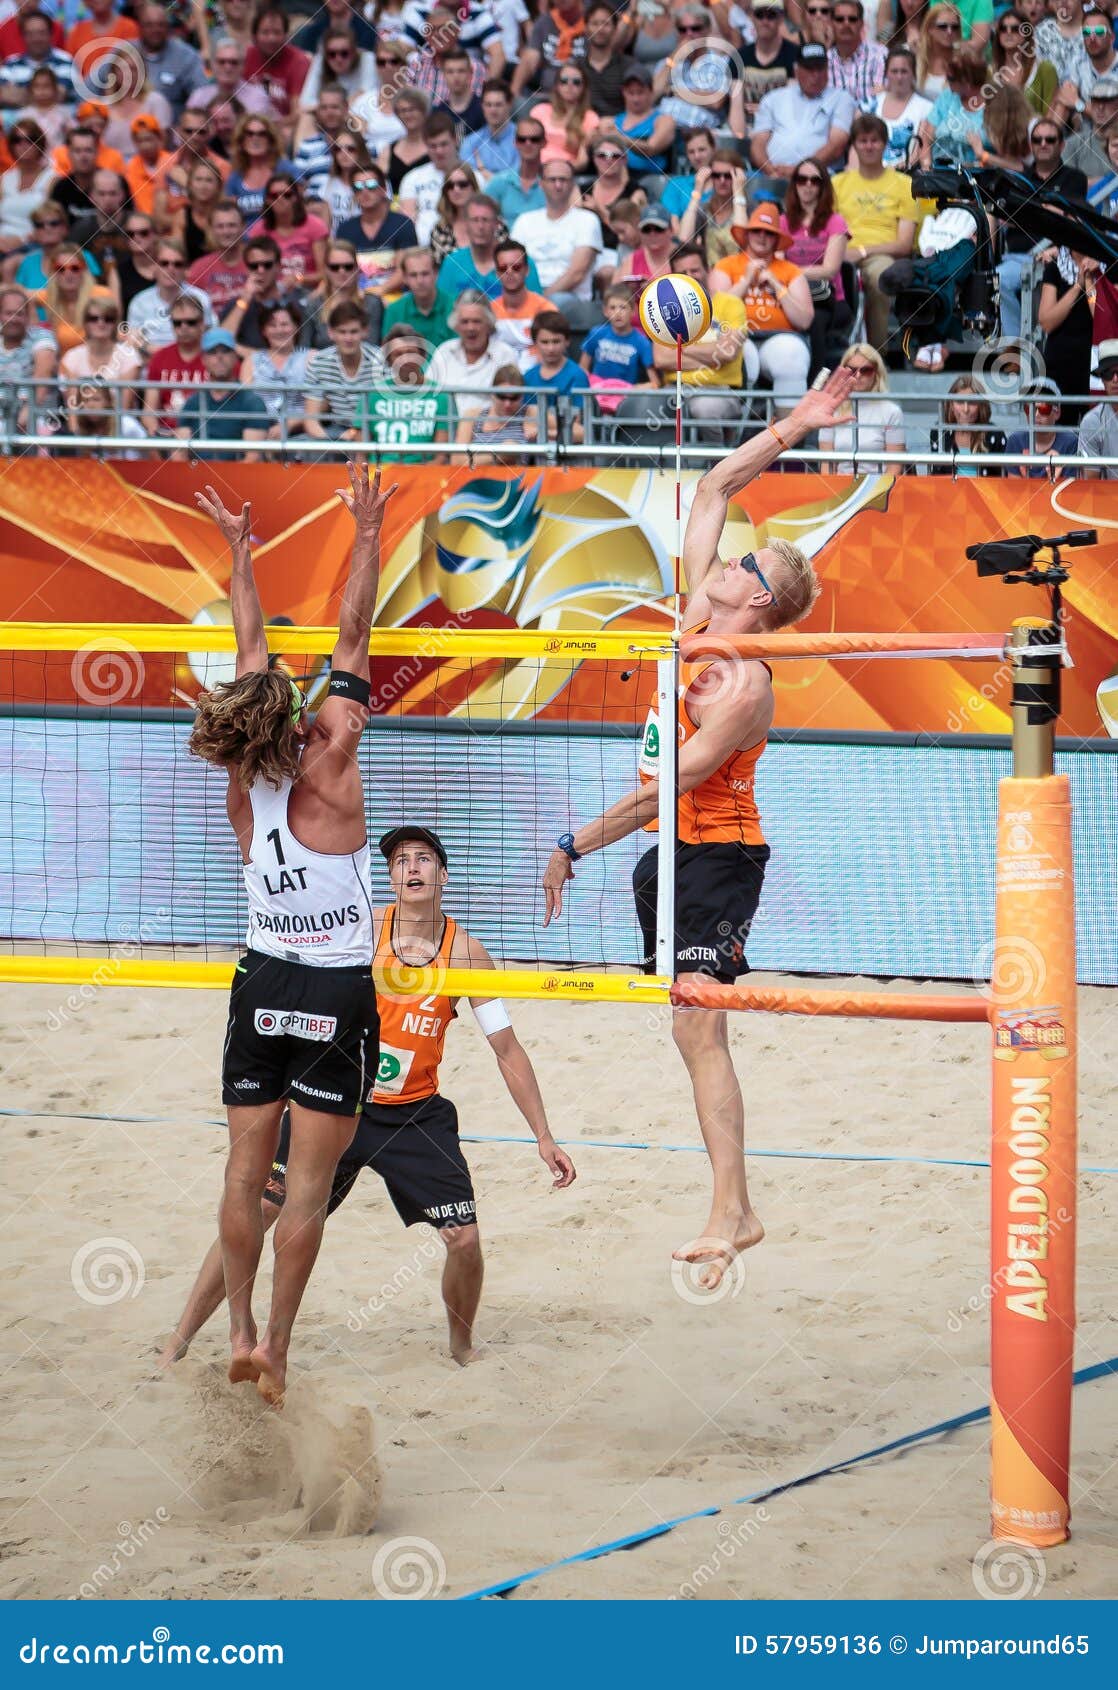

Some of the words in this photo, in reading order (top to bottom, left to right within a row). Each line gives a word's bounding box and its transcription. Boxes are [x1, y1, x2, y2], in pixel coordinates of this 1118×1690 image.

[688, 291, 701, 315] FIVB
[375, 399, 438, 418] SUPER
[267, 828, 286, 866] 1
[263, 867, 307, 896] LAT
[280, 1016, 335, 1034] OPTIBET
[233, 1080, 260, 1089] VENDEN
[291, 1080, 343, 1102] ALEKSANDRS
[1006, 1077, 1051, 1322] APELDOORN
[440, 1204, 455, 1218] DE
